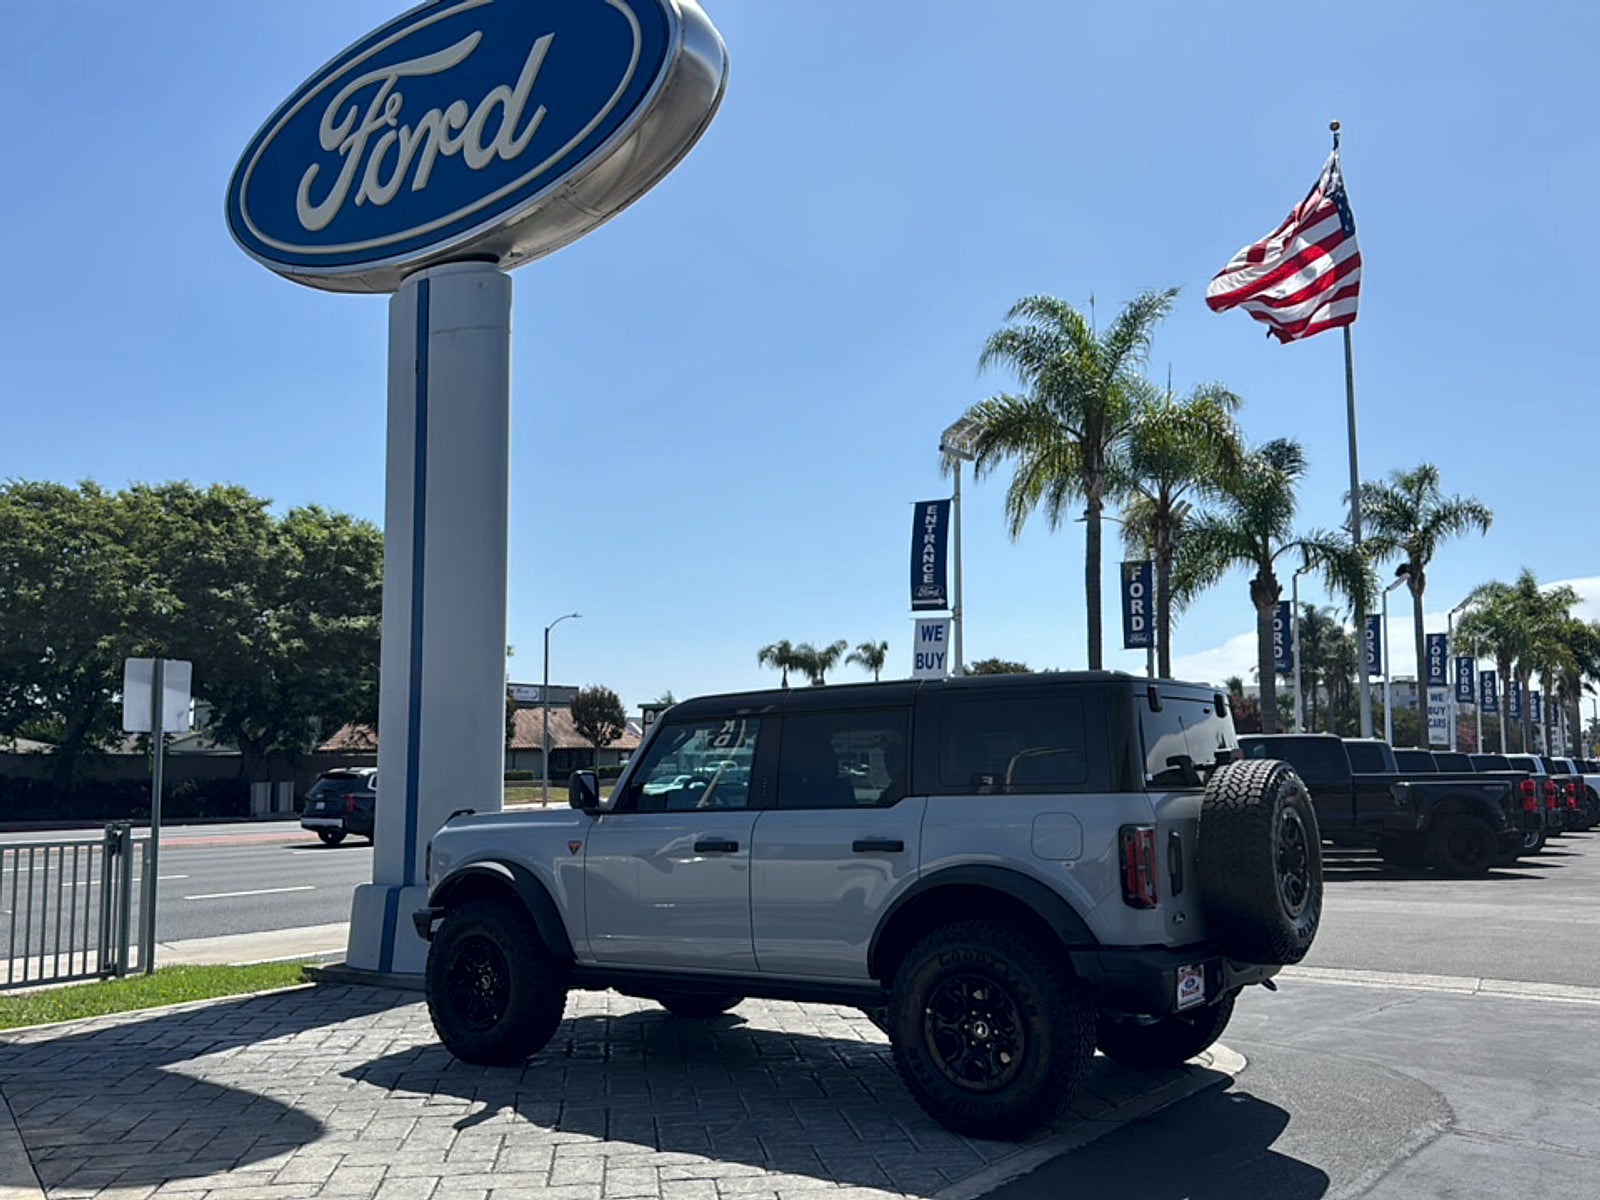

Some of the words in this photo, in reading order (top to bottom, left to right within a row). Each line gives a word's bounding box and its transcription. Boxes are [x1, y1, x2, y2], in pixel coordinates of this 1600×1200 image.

[296, 31, 555, 231] Ford
[922, 505, 938, 583] ENTRANCE
[1129, 566, 1144, 632] FORD
[921, 625, 943, 642] WE
[916, 652, 945, 670] BUY
[1431, 636, 1441, 676] FORD
[1460, 658, 1469, 693] FORD
[1484, 673, 1493, 704] FORD
[1428, 706, 1446, 715] BUY
[1430, 693, 1443, 702] WE
